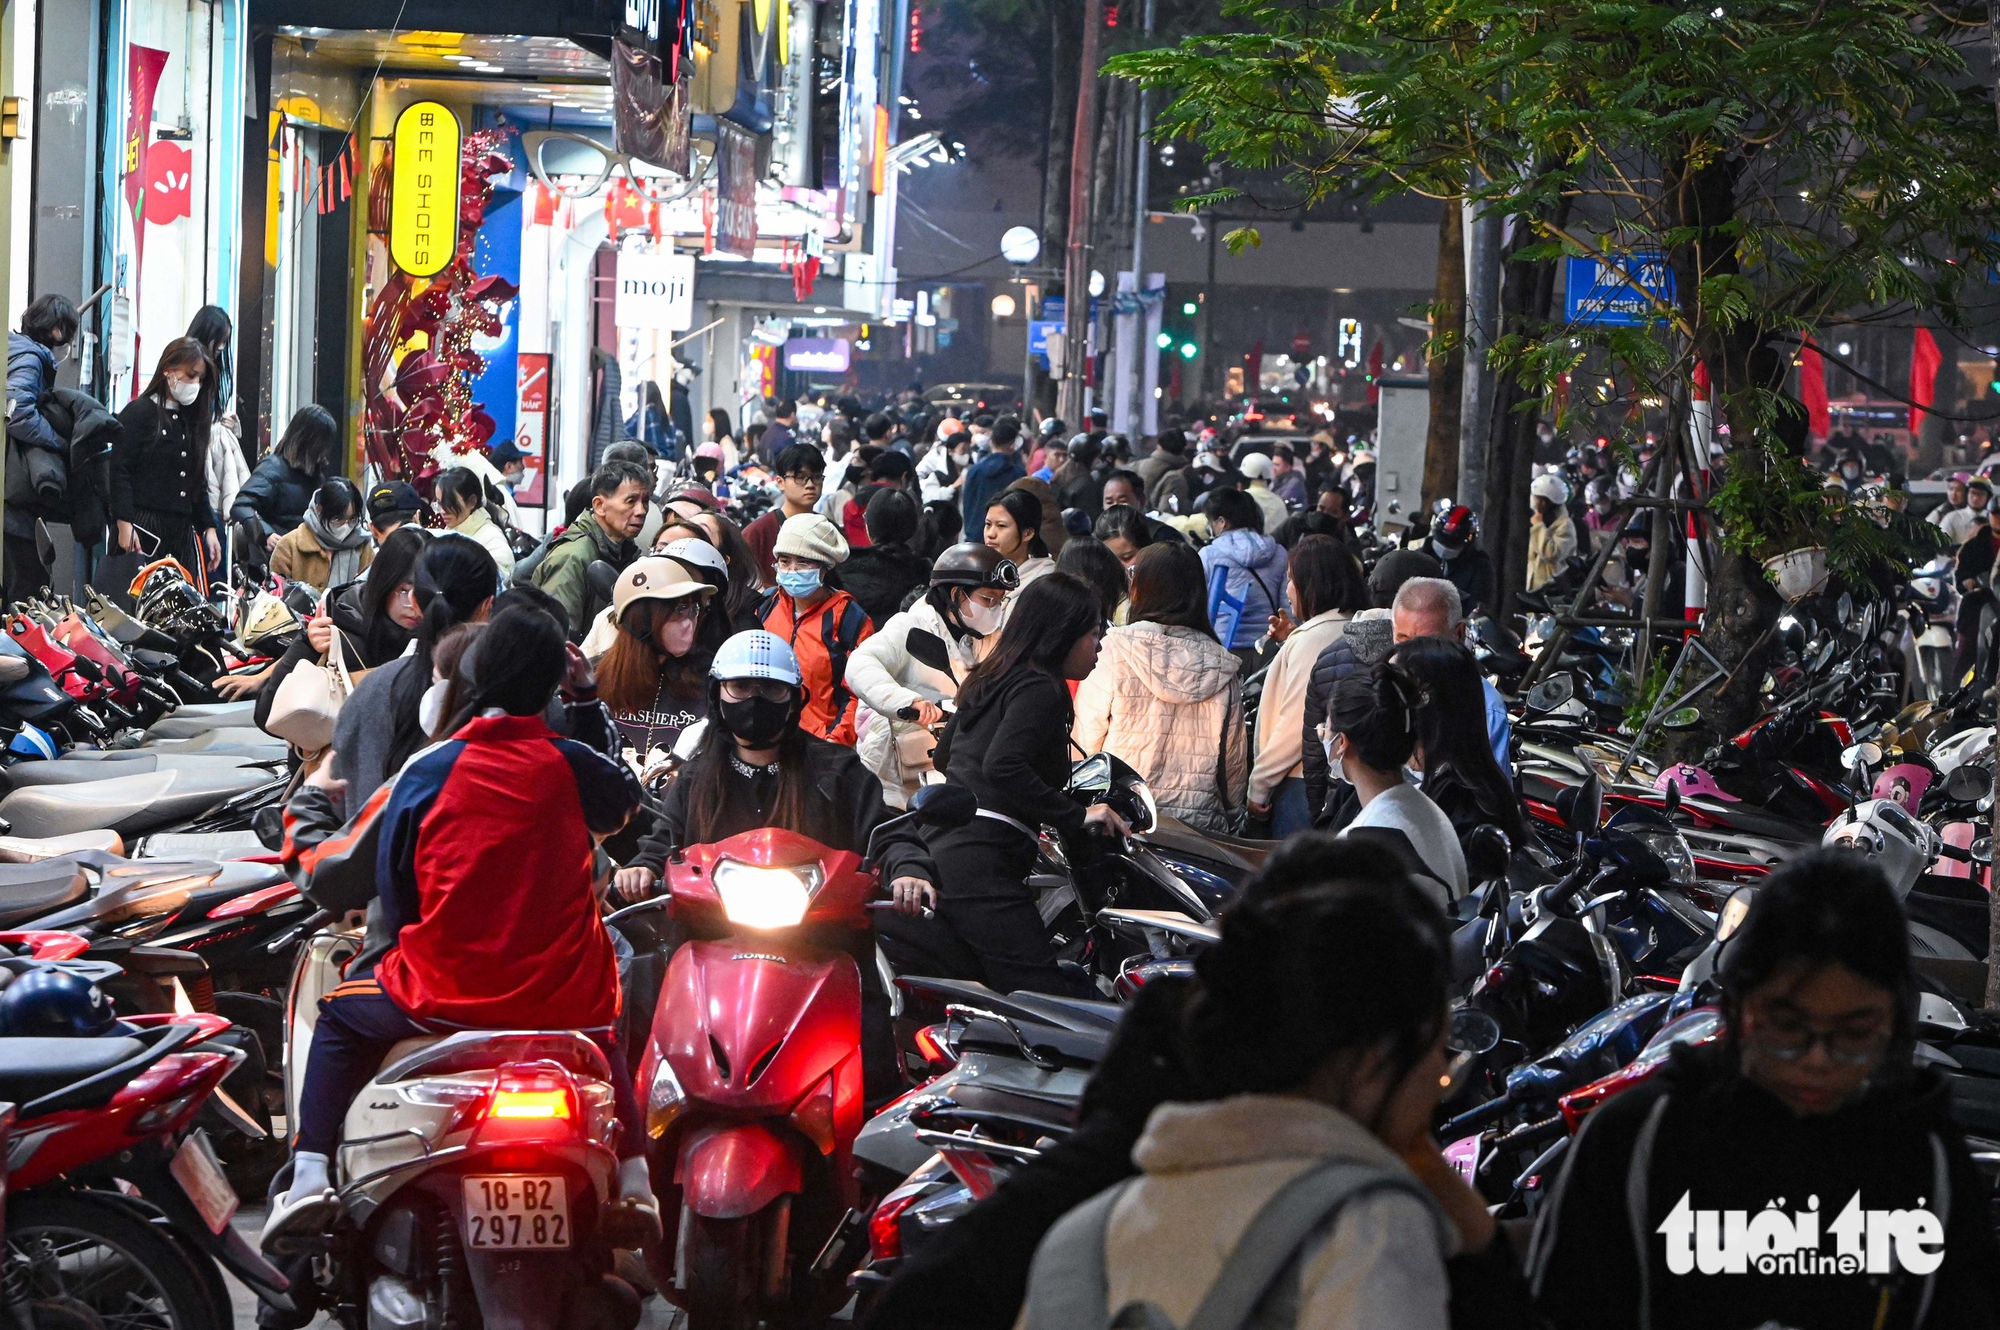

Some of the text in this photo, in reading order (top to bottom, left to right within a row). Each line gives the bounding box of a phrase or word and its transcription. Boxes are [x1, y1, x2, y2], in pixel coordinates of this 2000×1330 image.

[415, 113, 434, 265] BEE SHOES
[624, 276, 685, 305] moji
[731, 952, 788, 964] HONDA
[481, 1180, 553, 1211] 18-B2
[471, 1214, 566, 1246] 297.82
